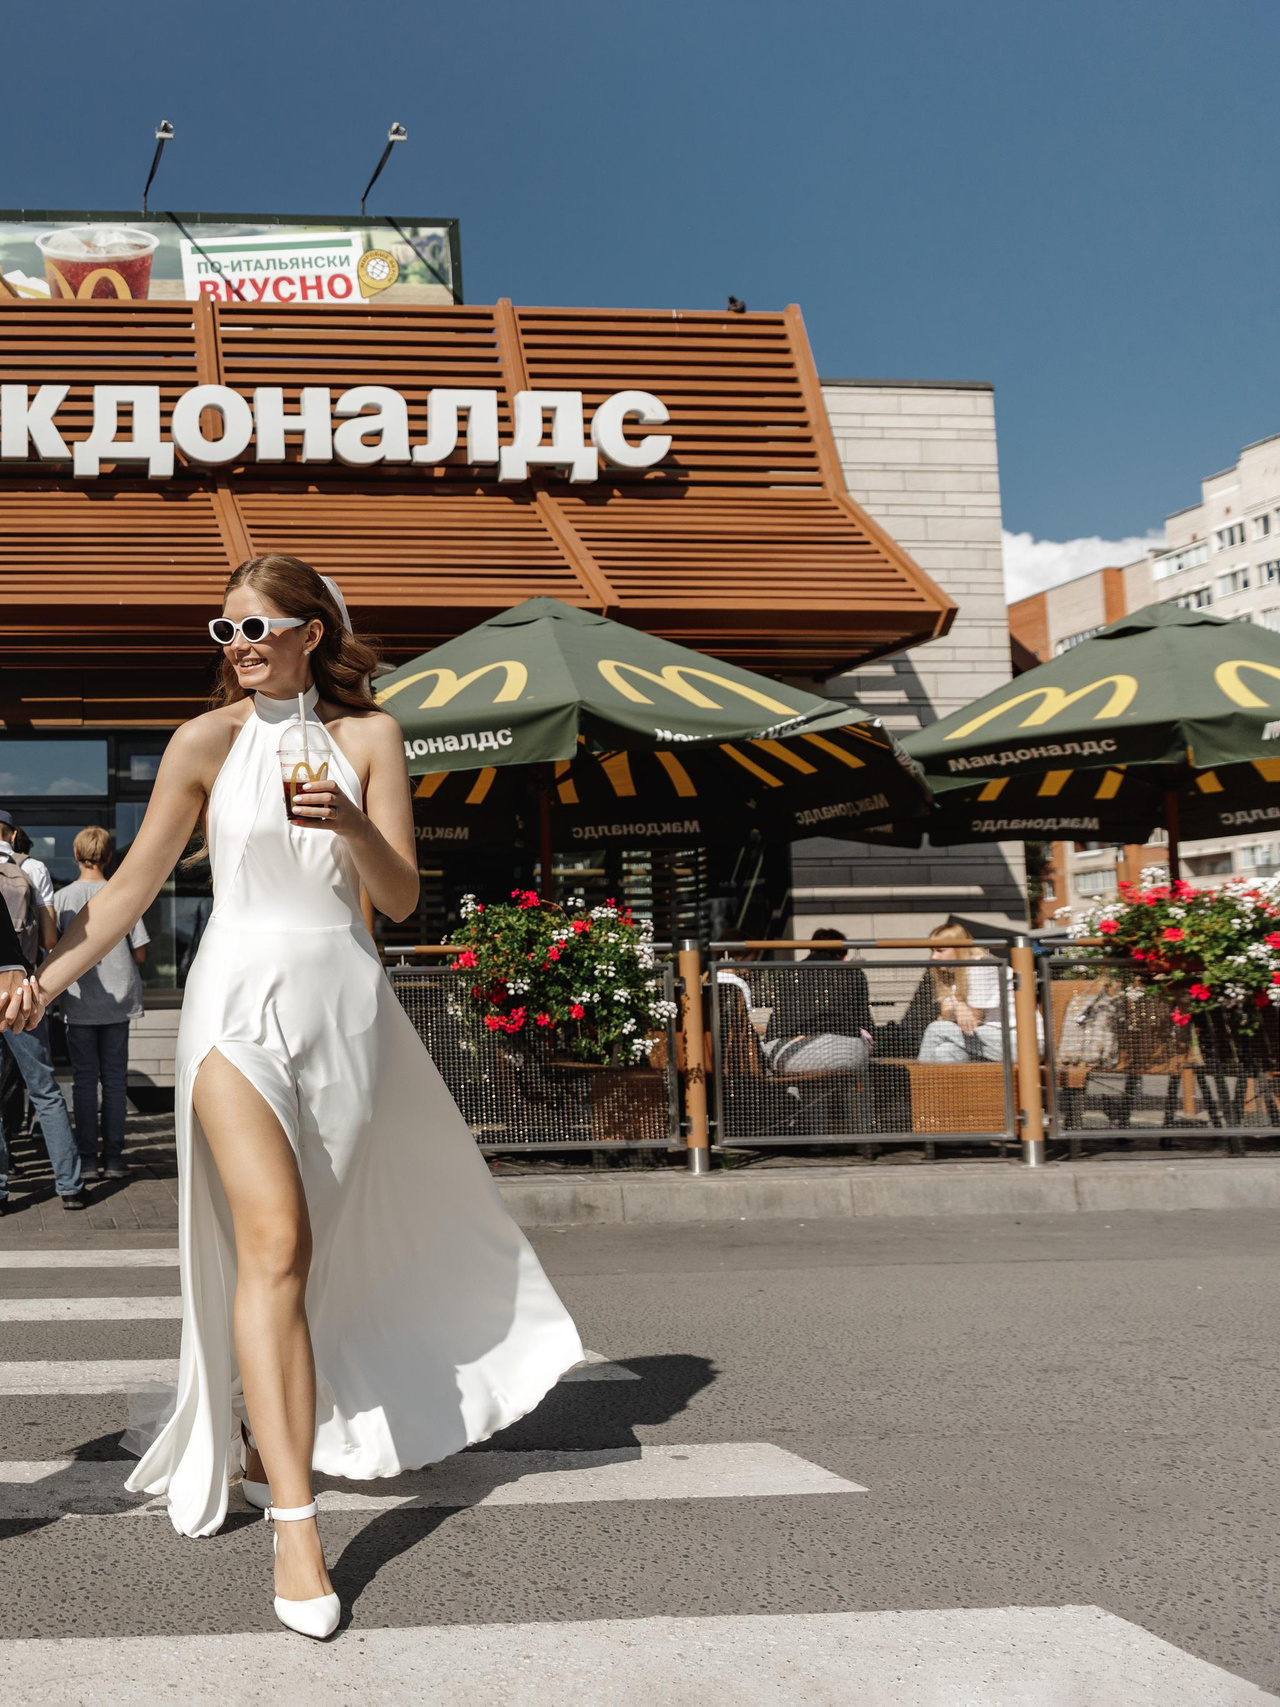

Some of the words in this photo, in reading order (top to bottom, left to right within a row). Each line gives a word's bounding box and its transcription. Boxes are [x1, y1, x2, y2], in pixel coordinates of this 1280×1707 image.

[197, 255, 351, 274] ПО-ИТАЛЬЯНСКИ
[199, 273, 353, 302] ВКУСНО
[948, 738, 1118, 773] Макдоналдс
